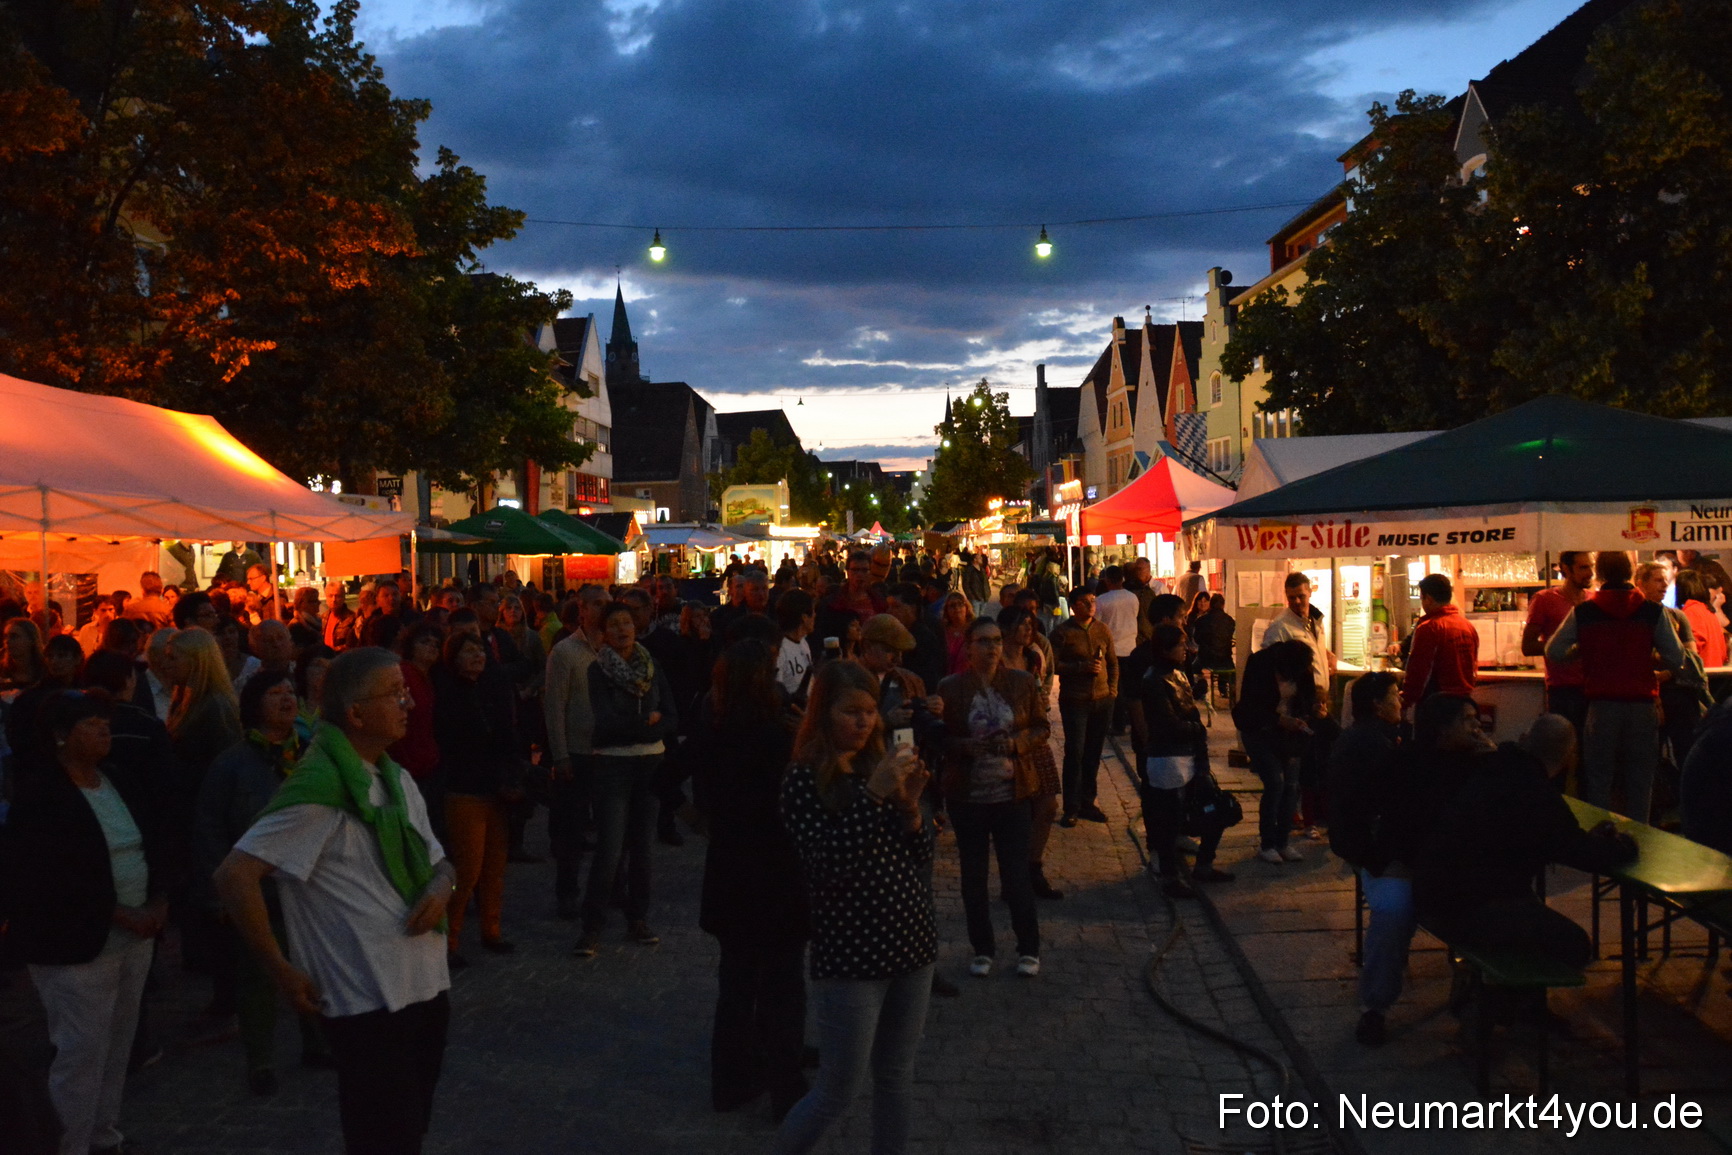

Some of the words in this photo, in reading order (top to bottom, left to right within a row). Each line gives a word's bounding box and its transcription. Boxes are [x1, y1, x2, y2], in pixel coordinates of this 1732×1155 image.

[379, 479, 400, 488] MATT
[1234, 519, 1371, 551] West-Side
[1377, 532, 1440, 547] MUSIC
[1445, 527, 1516, 545] STORE
